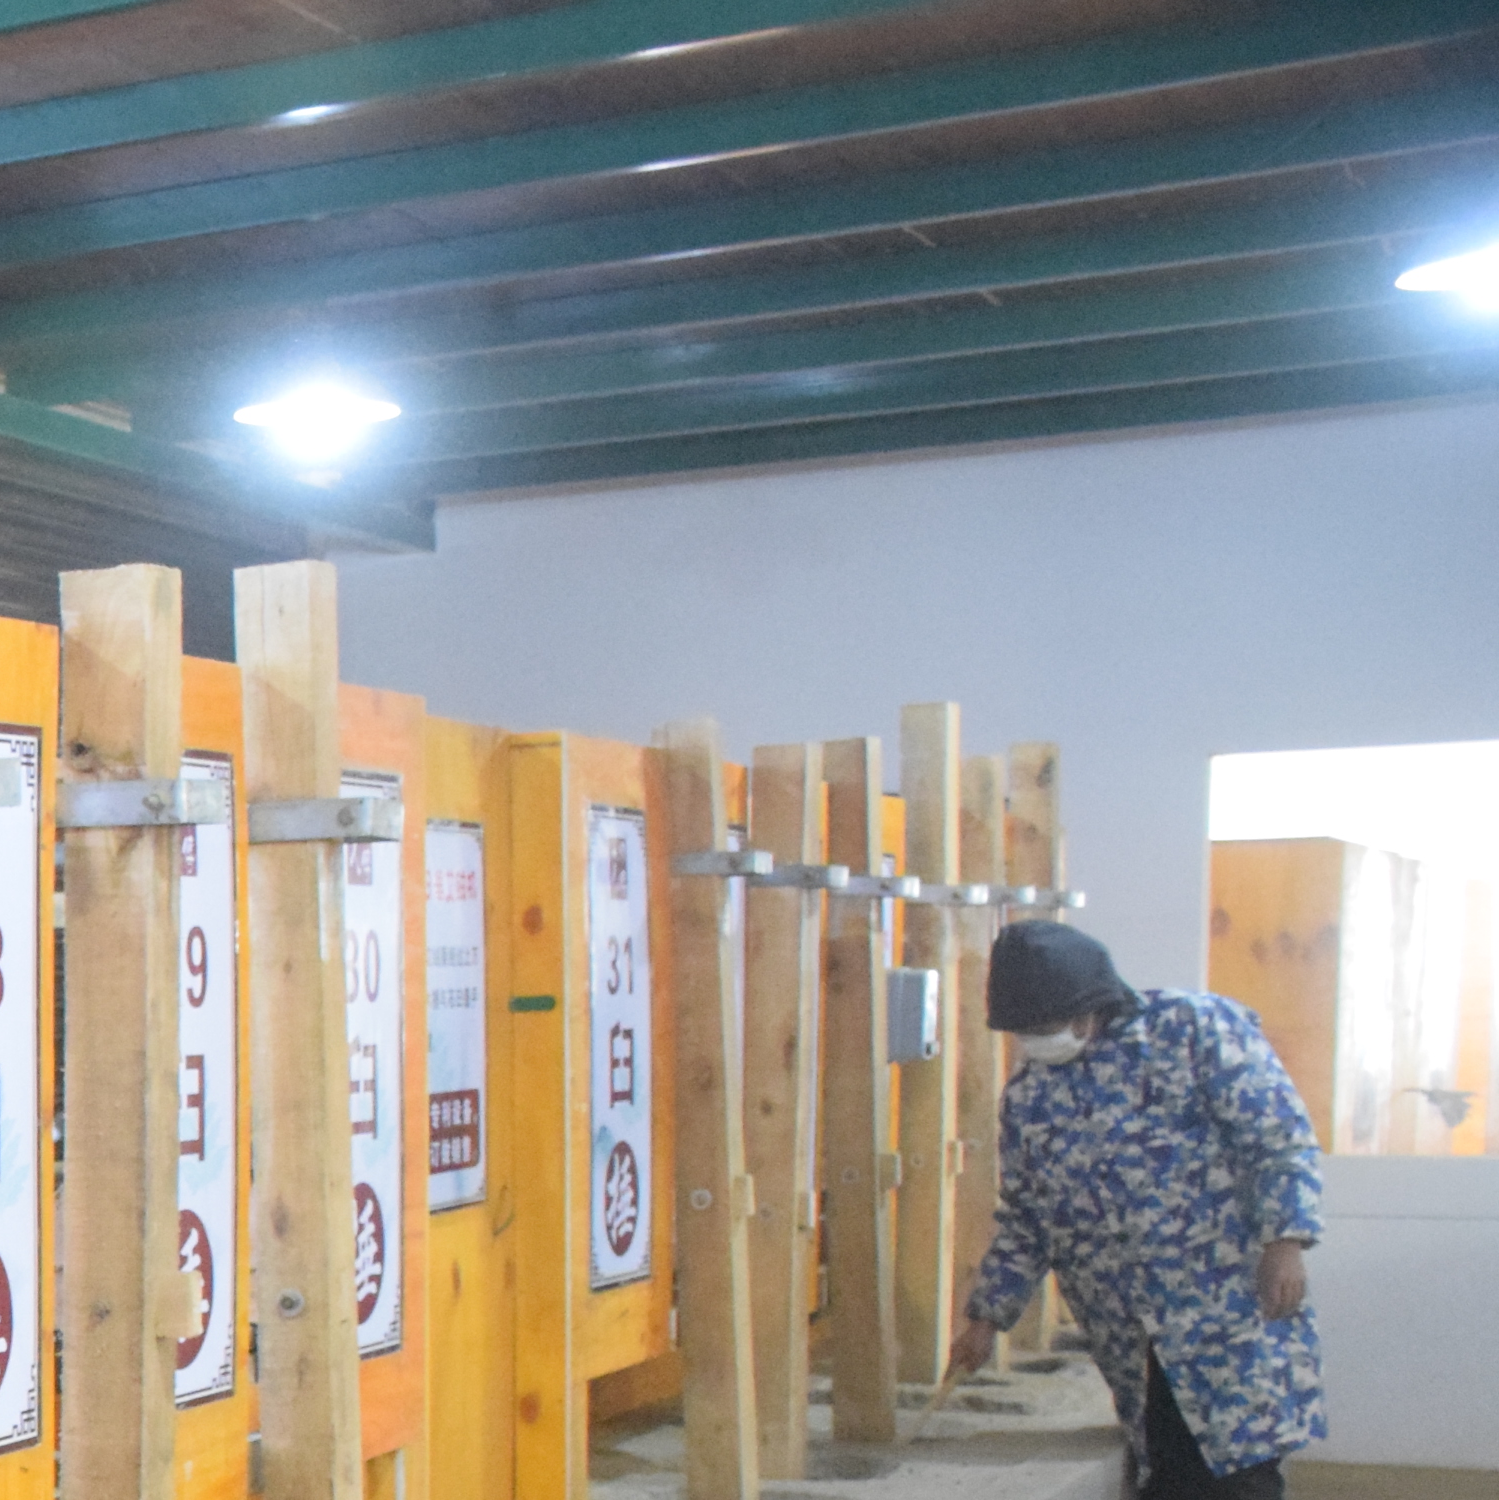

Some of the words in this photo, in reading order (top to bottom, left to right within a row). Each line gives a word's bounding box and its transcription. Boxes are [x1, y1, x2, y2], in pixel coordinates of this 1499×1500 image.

[185, 925, 208, 1009] 9
[607, 937, 635, 996] 31
[609, 1022, 635, 1109] 臼
